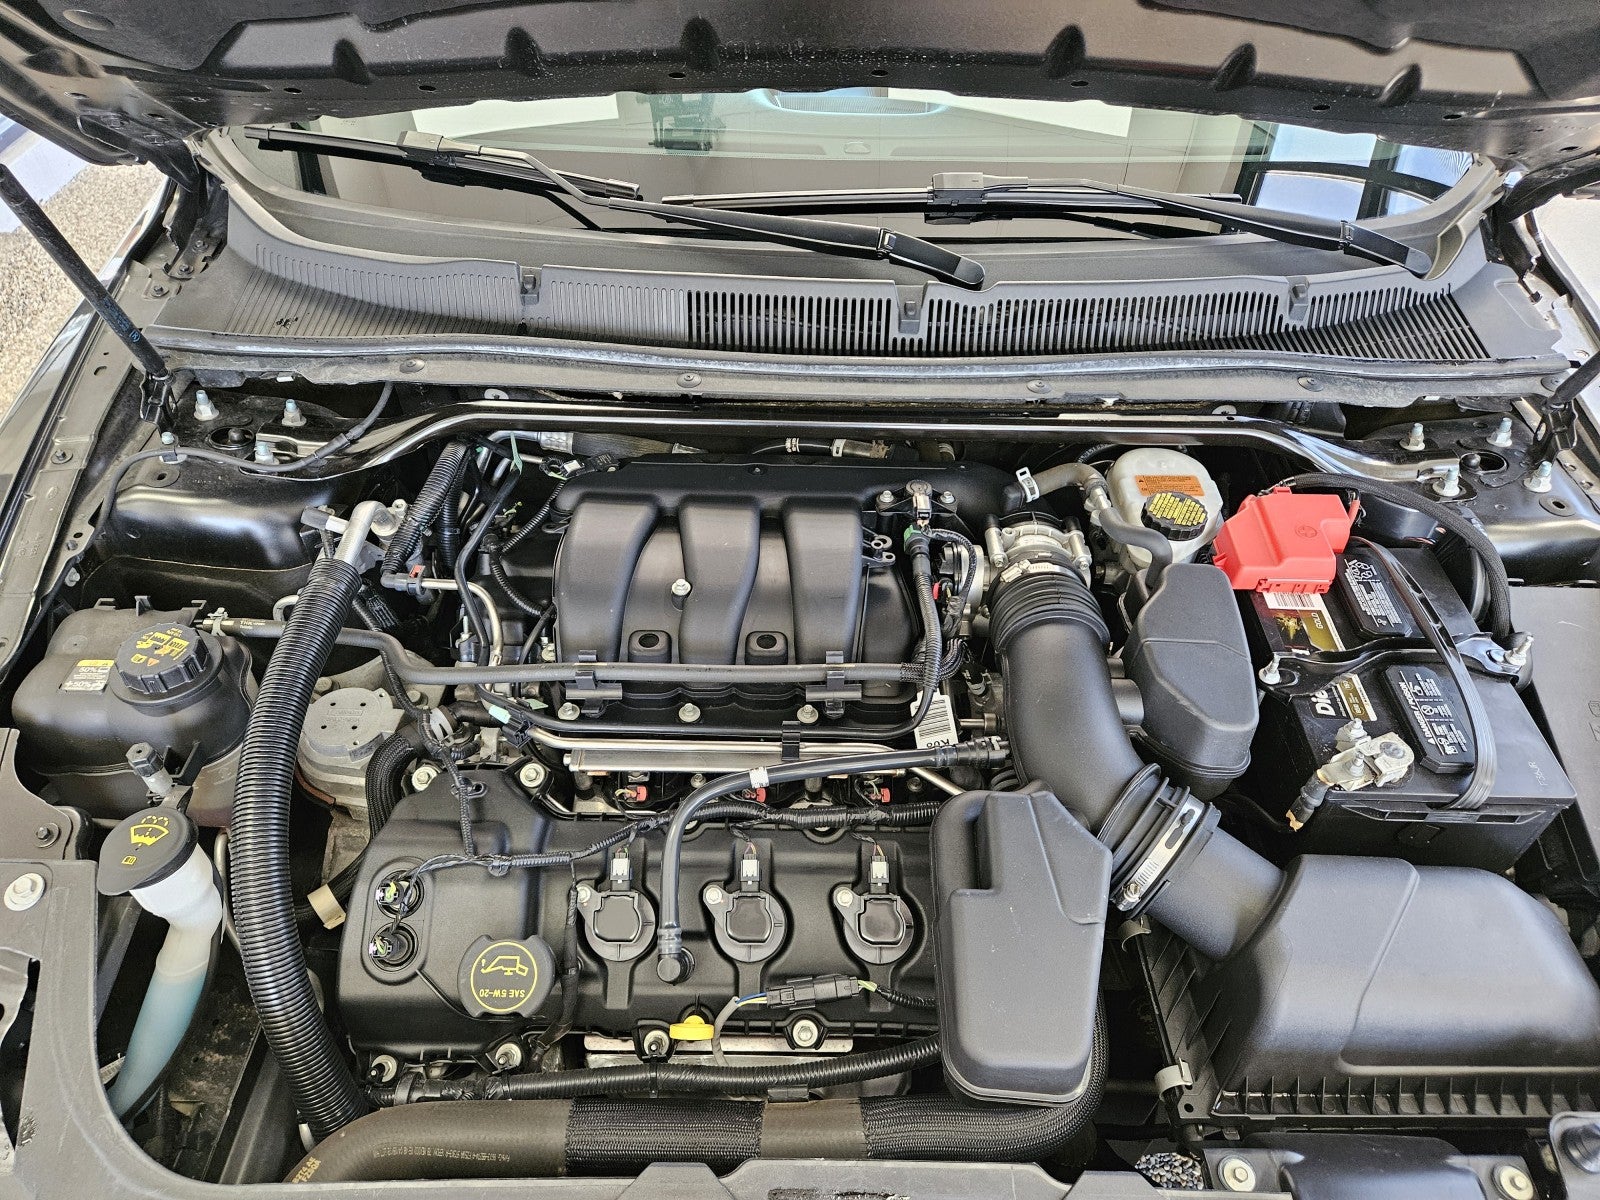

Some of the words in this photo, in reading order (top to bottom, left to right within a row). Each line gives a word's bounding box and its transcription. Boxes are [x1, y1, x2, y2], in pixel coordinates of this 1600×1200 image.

[1398, 682, 1415, 705] POISON
[1413, 711, 1432, 738] DANGER
[479, 988, 507, 998] 5W-20
[509, 988, 526, 998] SAE
